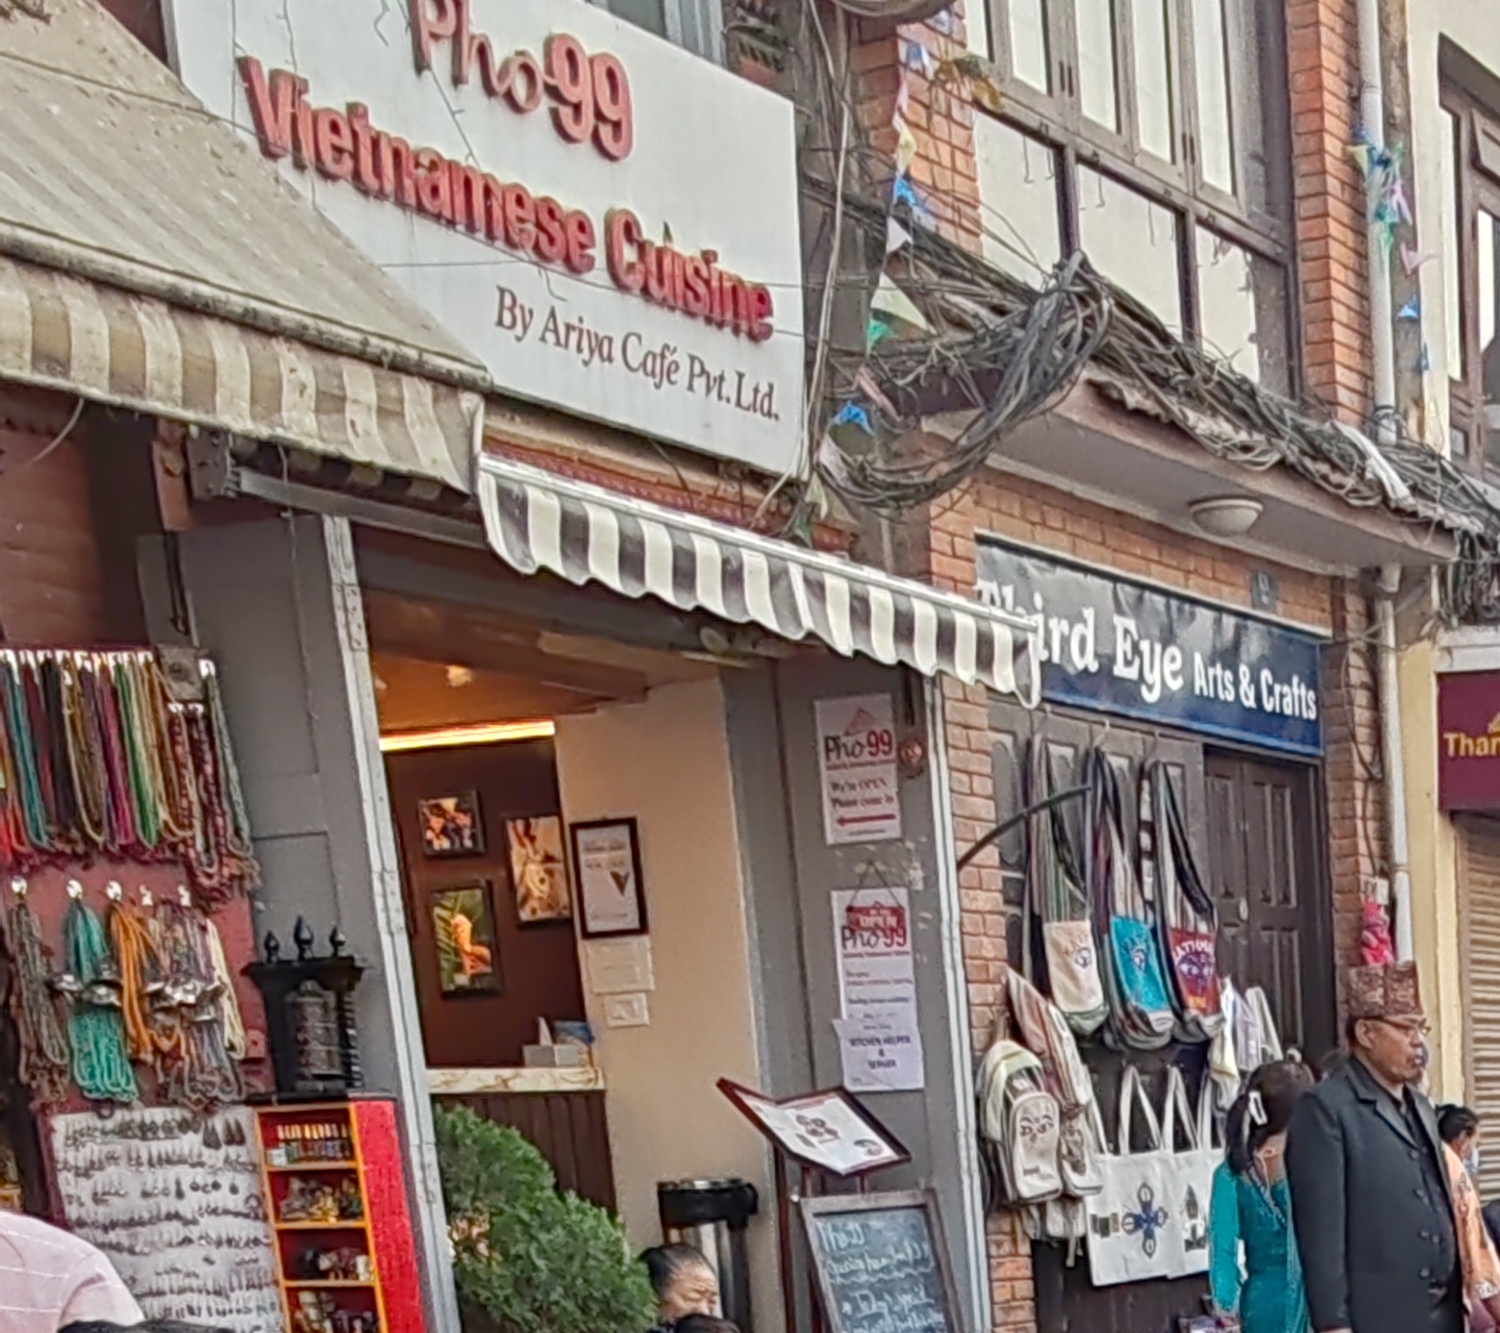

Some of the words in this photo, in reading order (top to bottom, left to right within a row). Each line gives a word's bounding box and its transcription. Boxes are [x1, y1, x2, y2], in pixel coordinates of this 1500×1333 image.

[236, 55, 596, 275] Vietnamese
[604, 208, 774, 343] Cuisine
[494, 284, 533, 342] By
[539, 304, 614, 367] Ariya
[621, 332, 680, 390] Café
[1113, 613, 1184, 705] Eye
[1193, 652, 1235, 702] Arts
[1239, 662, 1257, 710] &
[1260, 667, 1318, 721] Crafts
